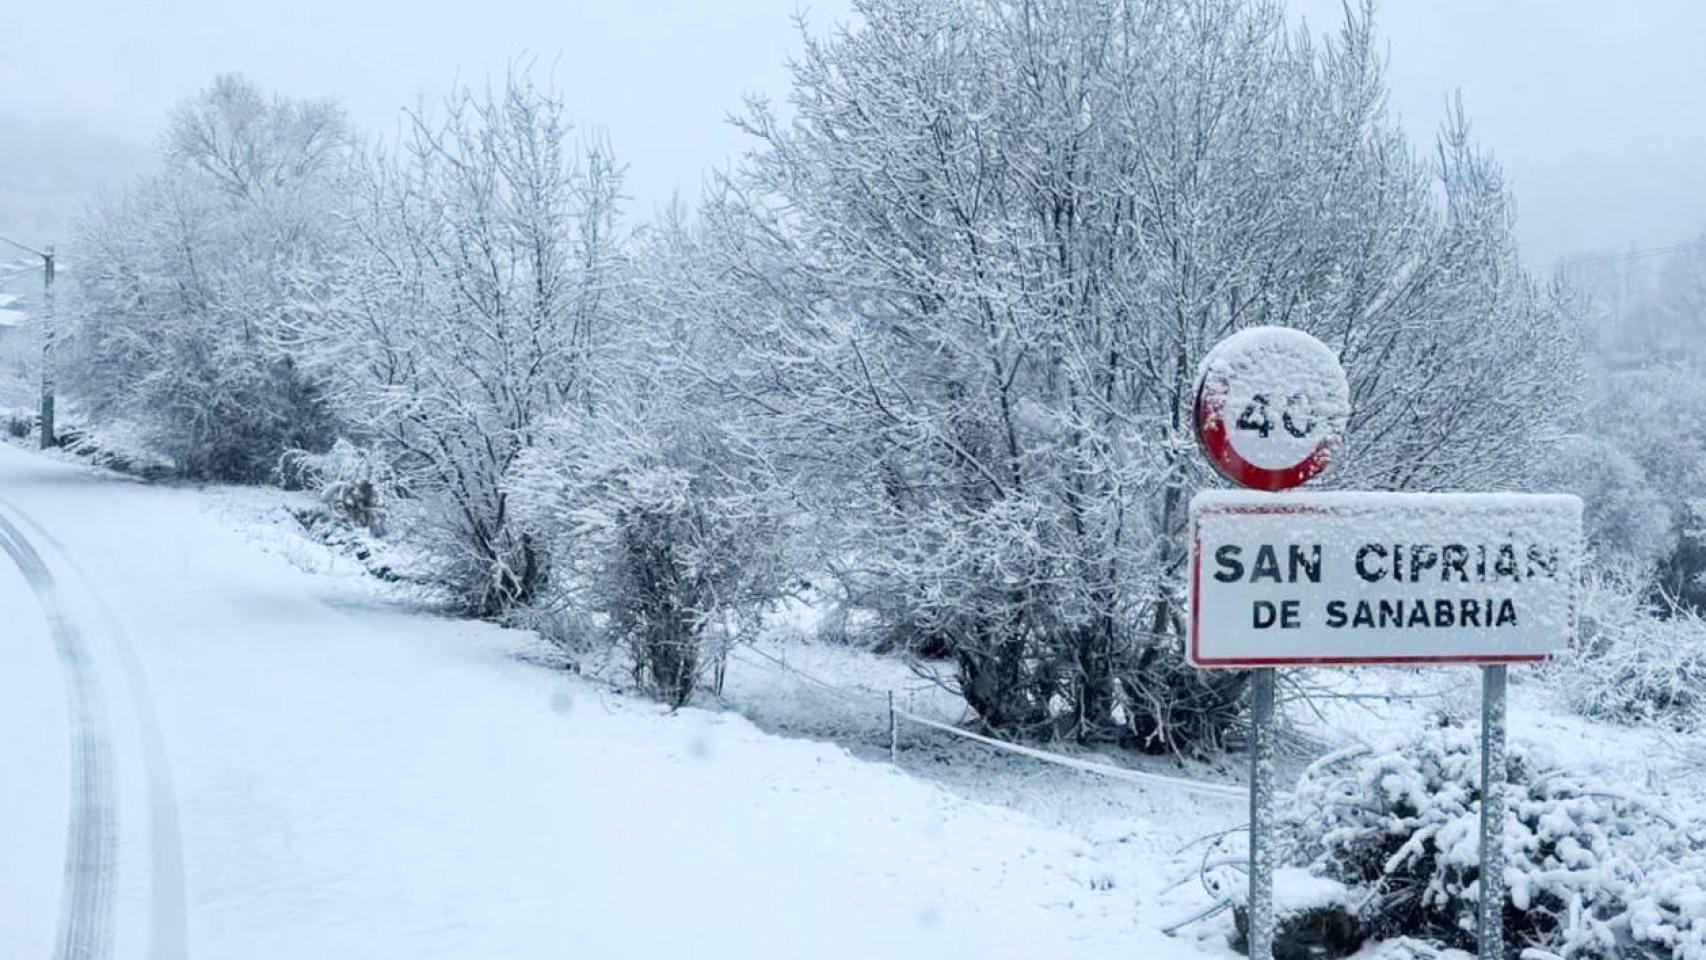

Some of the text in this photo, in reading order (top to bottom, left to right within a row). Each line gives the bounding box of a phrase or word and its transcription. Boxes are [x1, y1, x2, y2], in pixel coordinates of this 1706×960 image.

[1236, 393, 1316, 439] 40
[1213, 543, 1322, 584] SAN
[1252, 598, 1518, 629] DE SANABRIA
